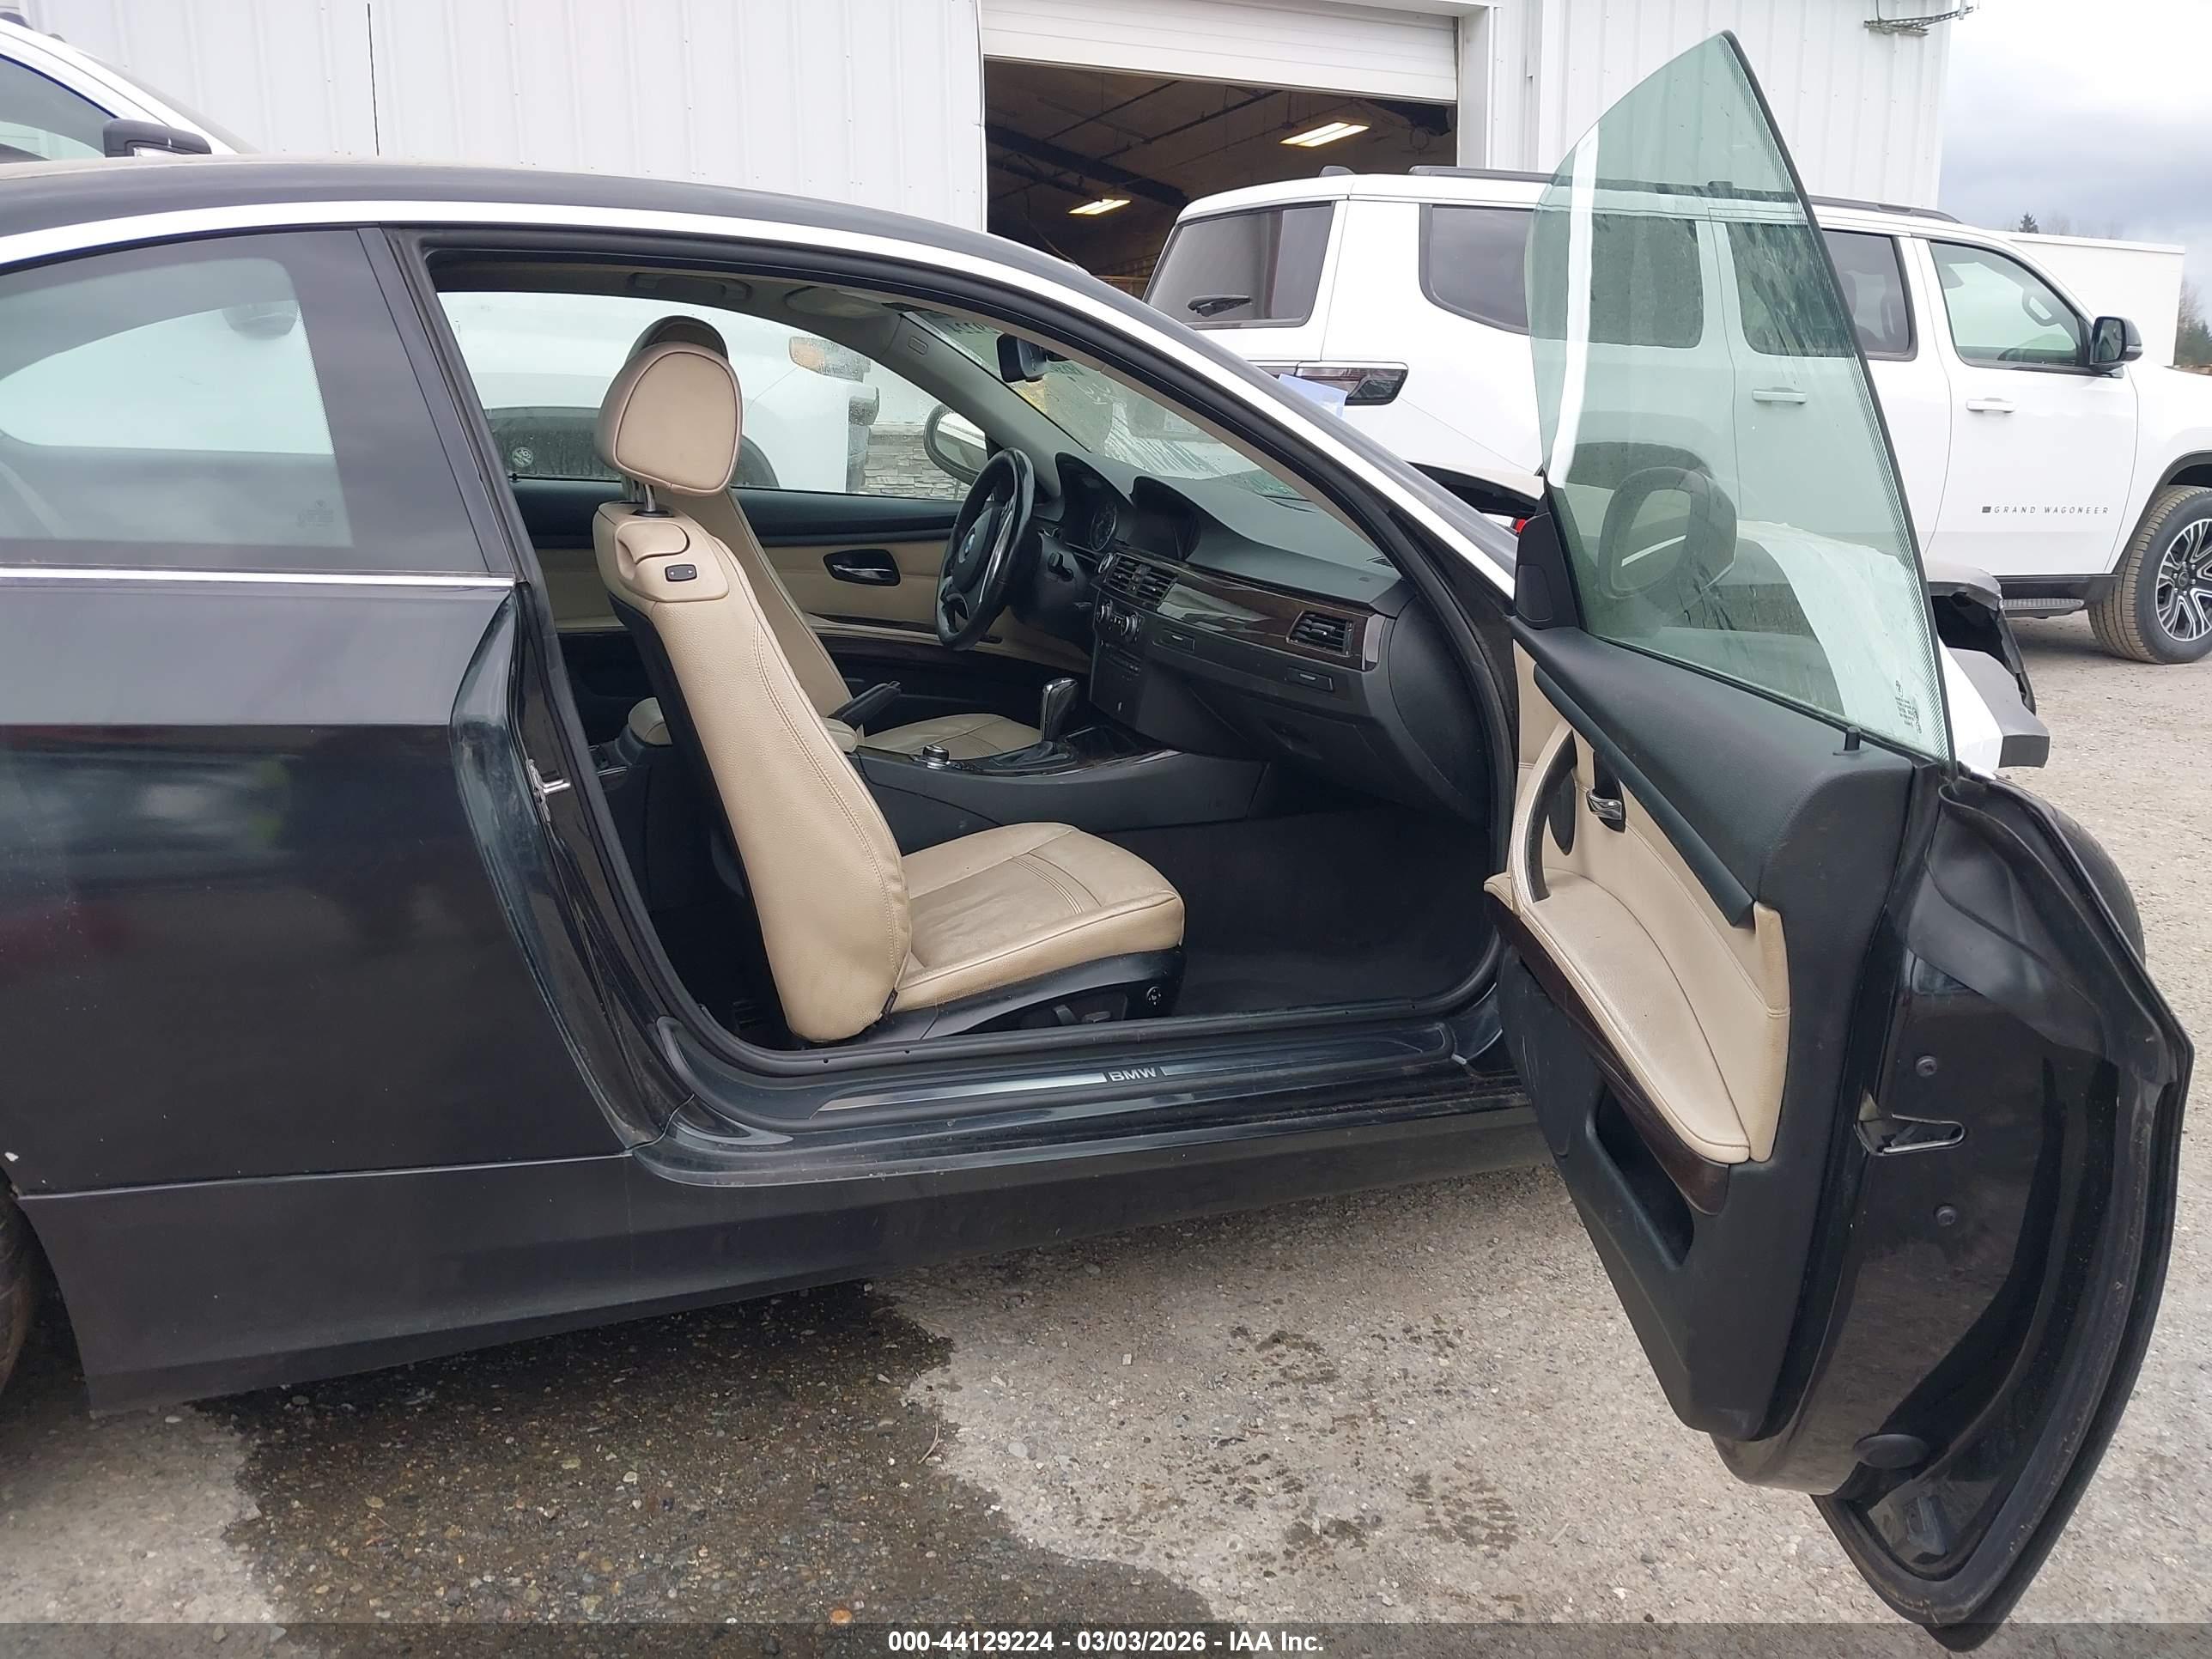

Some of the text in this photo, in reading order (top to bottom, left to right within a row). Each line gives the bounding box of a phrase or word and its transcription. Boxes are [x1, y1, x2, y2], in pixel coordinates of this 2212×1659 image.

[1994, 506, 2109, 514] GRAND WAGONEER
[1108, 1066, 1157, 1082] BMW
